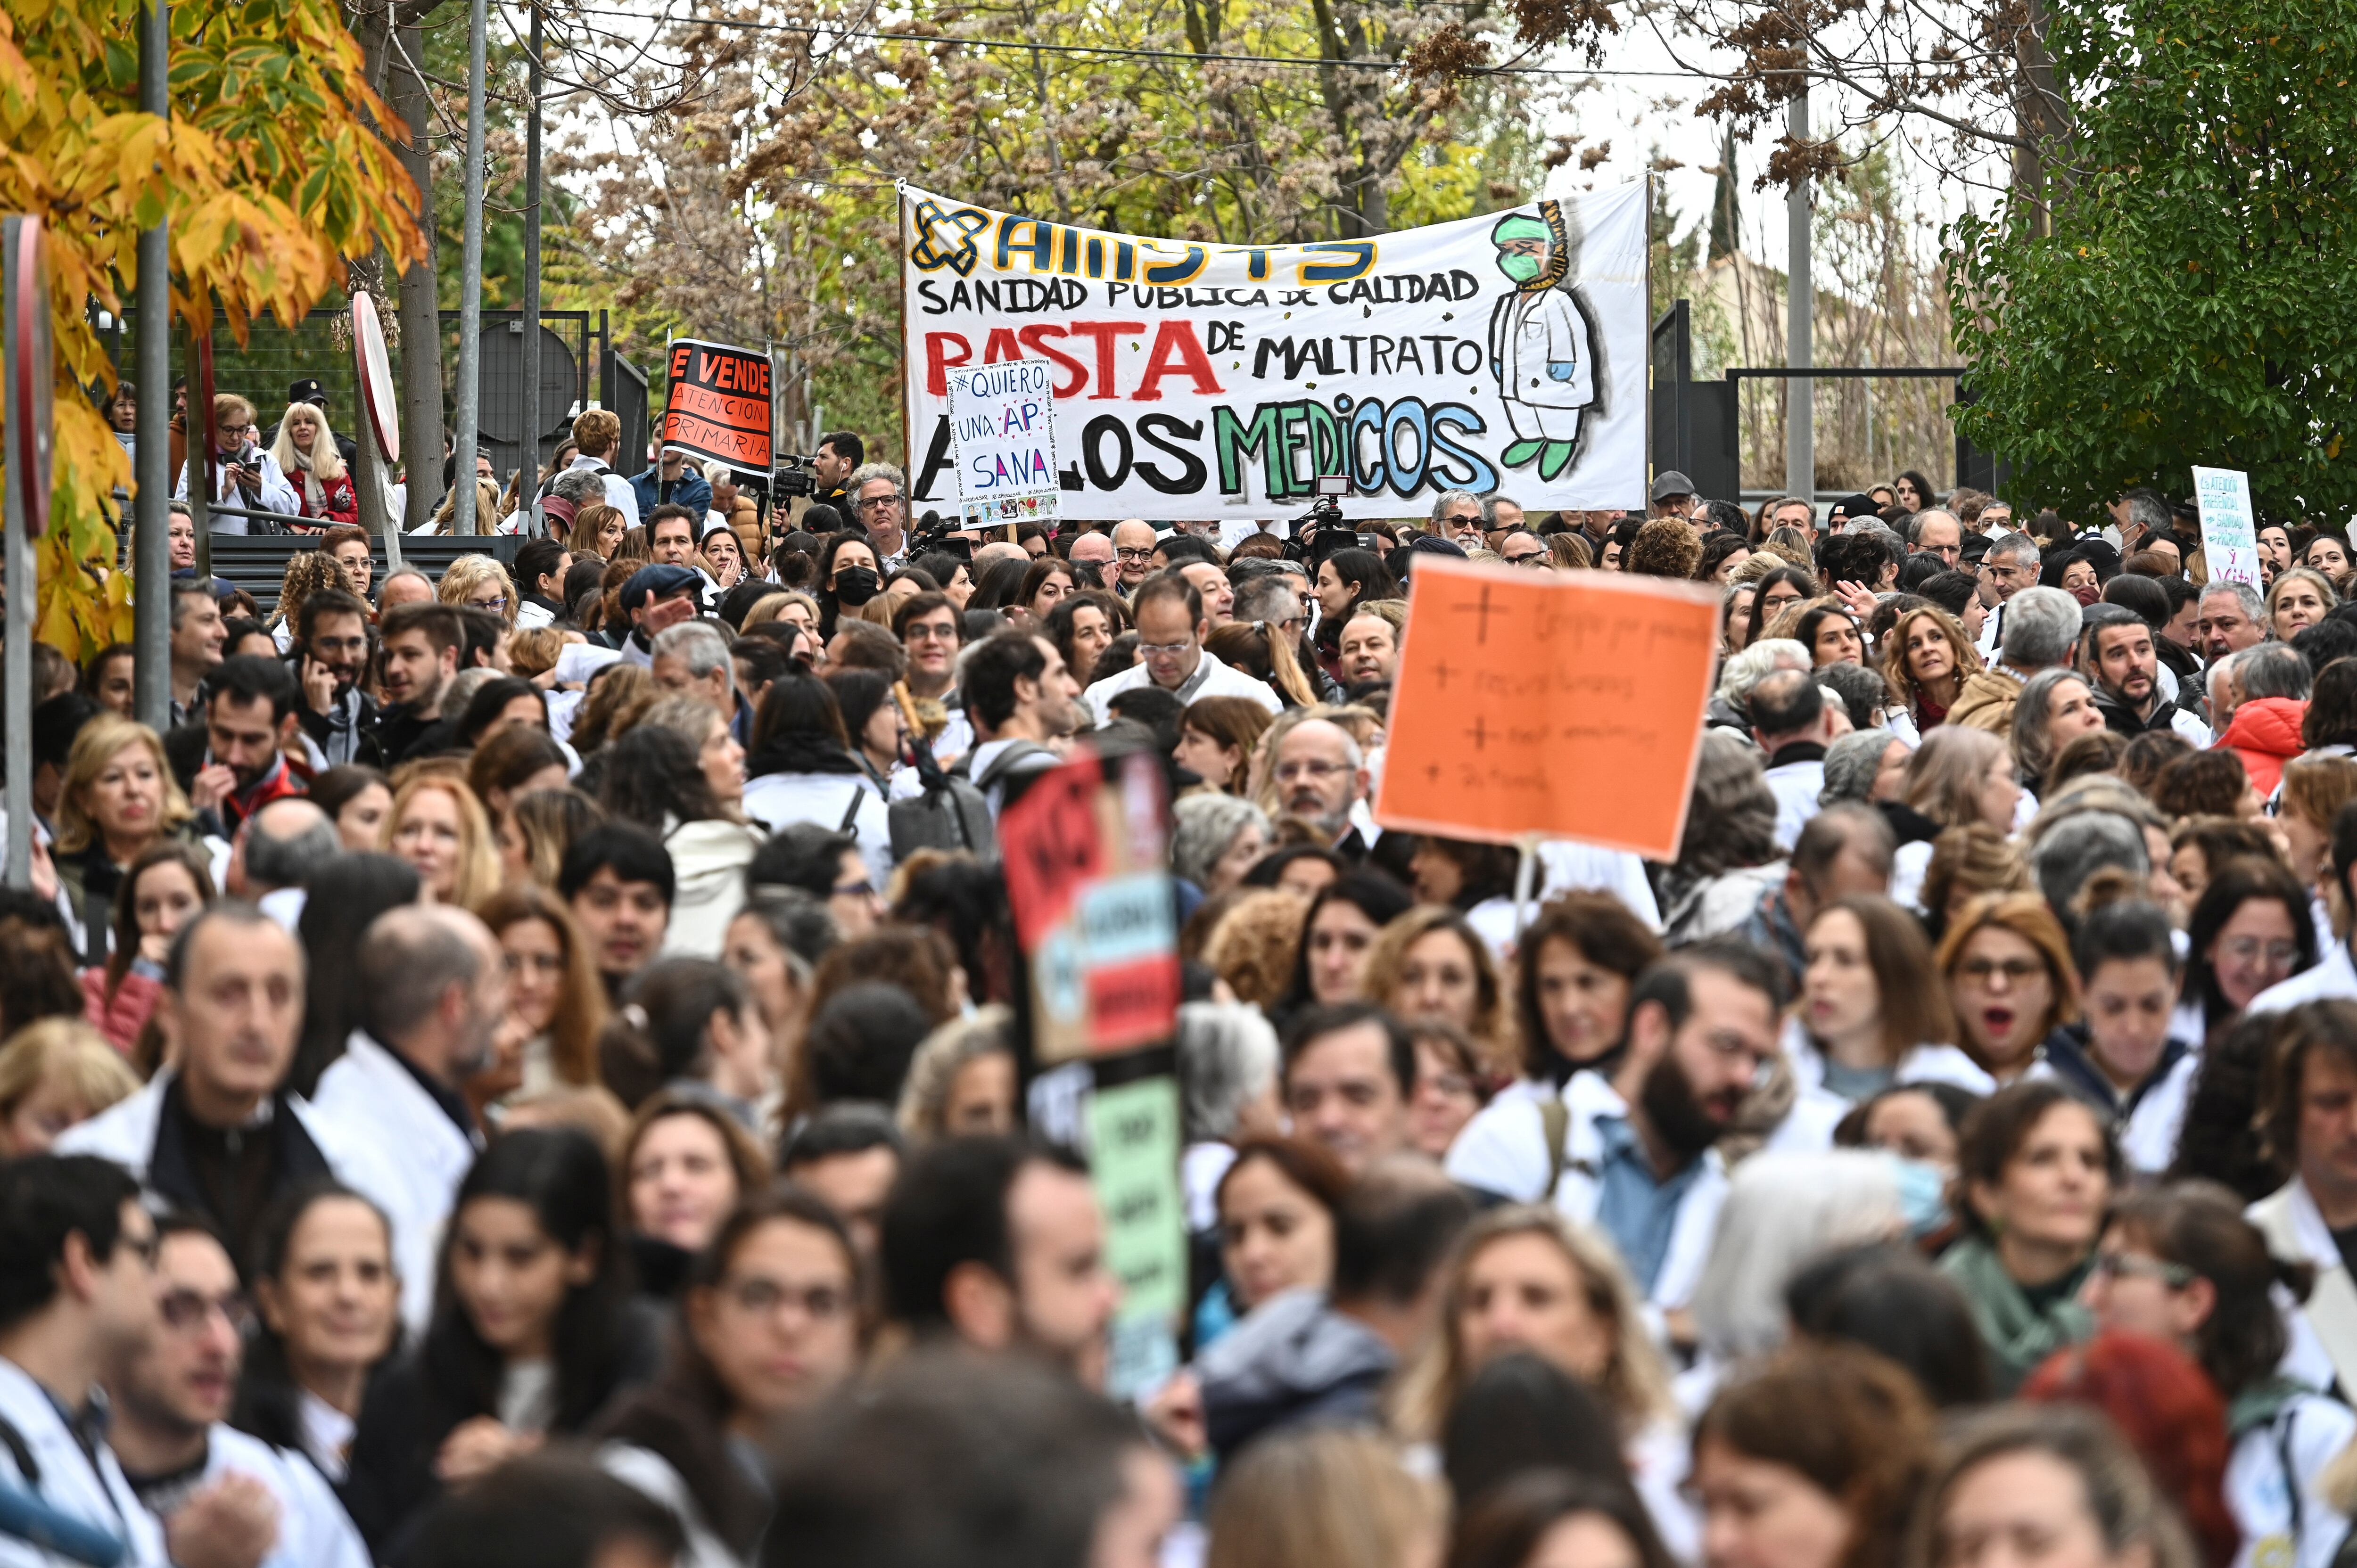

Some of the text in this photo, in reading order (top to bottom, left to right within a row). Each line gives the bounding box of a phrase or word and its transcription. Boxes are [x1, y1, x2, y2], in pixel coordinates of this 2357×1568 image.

[918, 270, 1479, 314] SANIDAD PUBLICA DE CALIDAD
[1207, 320, 1245, 355] DE
[1252, 335, 1482, 380] MALTRATO
[670, 348, 769, 396] E VENDE
[952, 366, 1044, 398] #QUIERO
[958, 414, 995, 441] UNA
[973, 448, 1050, 489] SANA
[1059, 413, 1208, 495] OS
[2201, 476, 2209, 490] La
